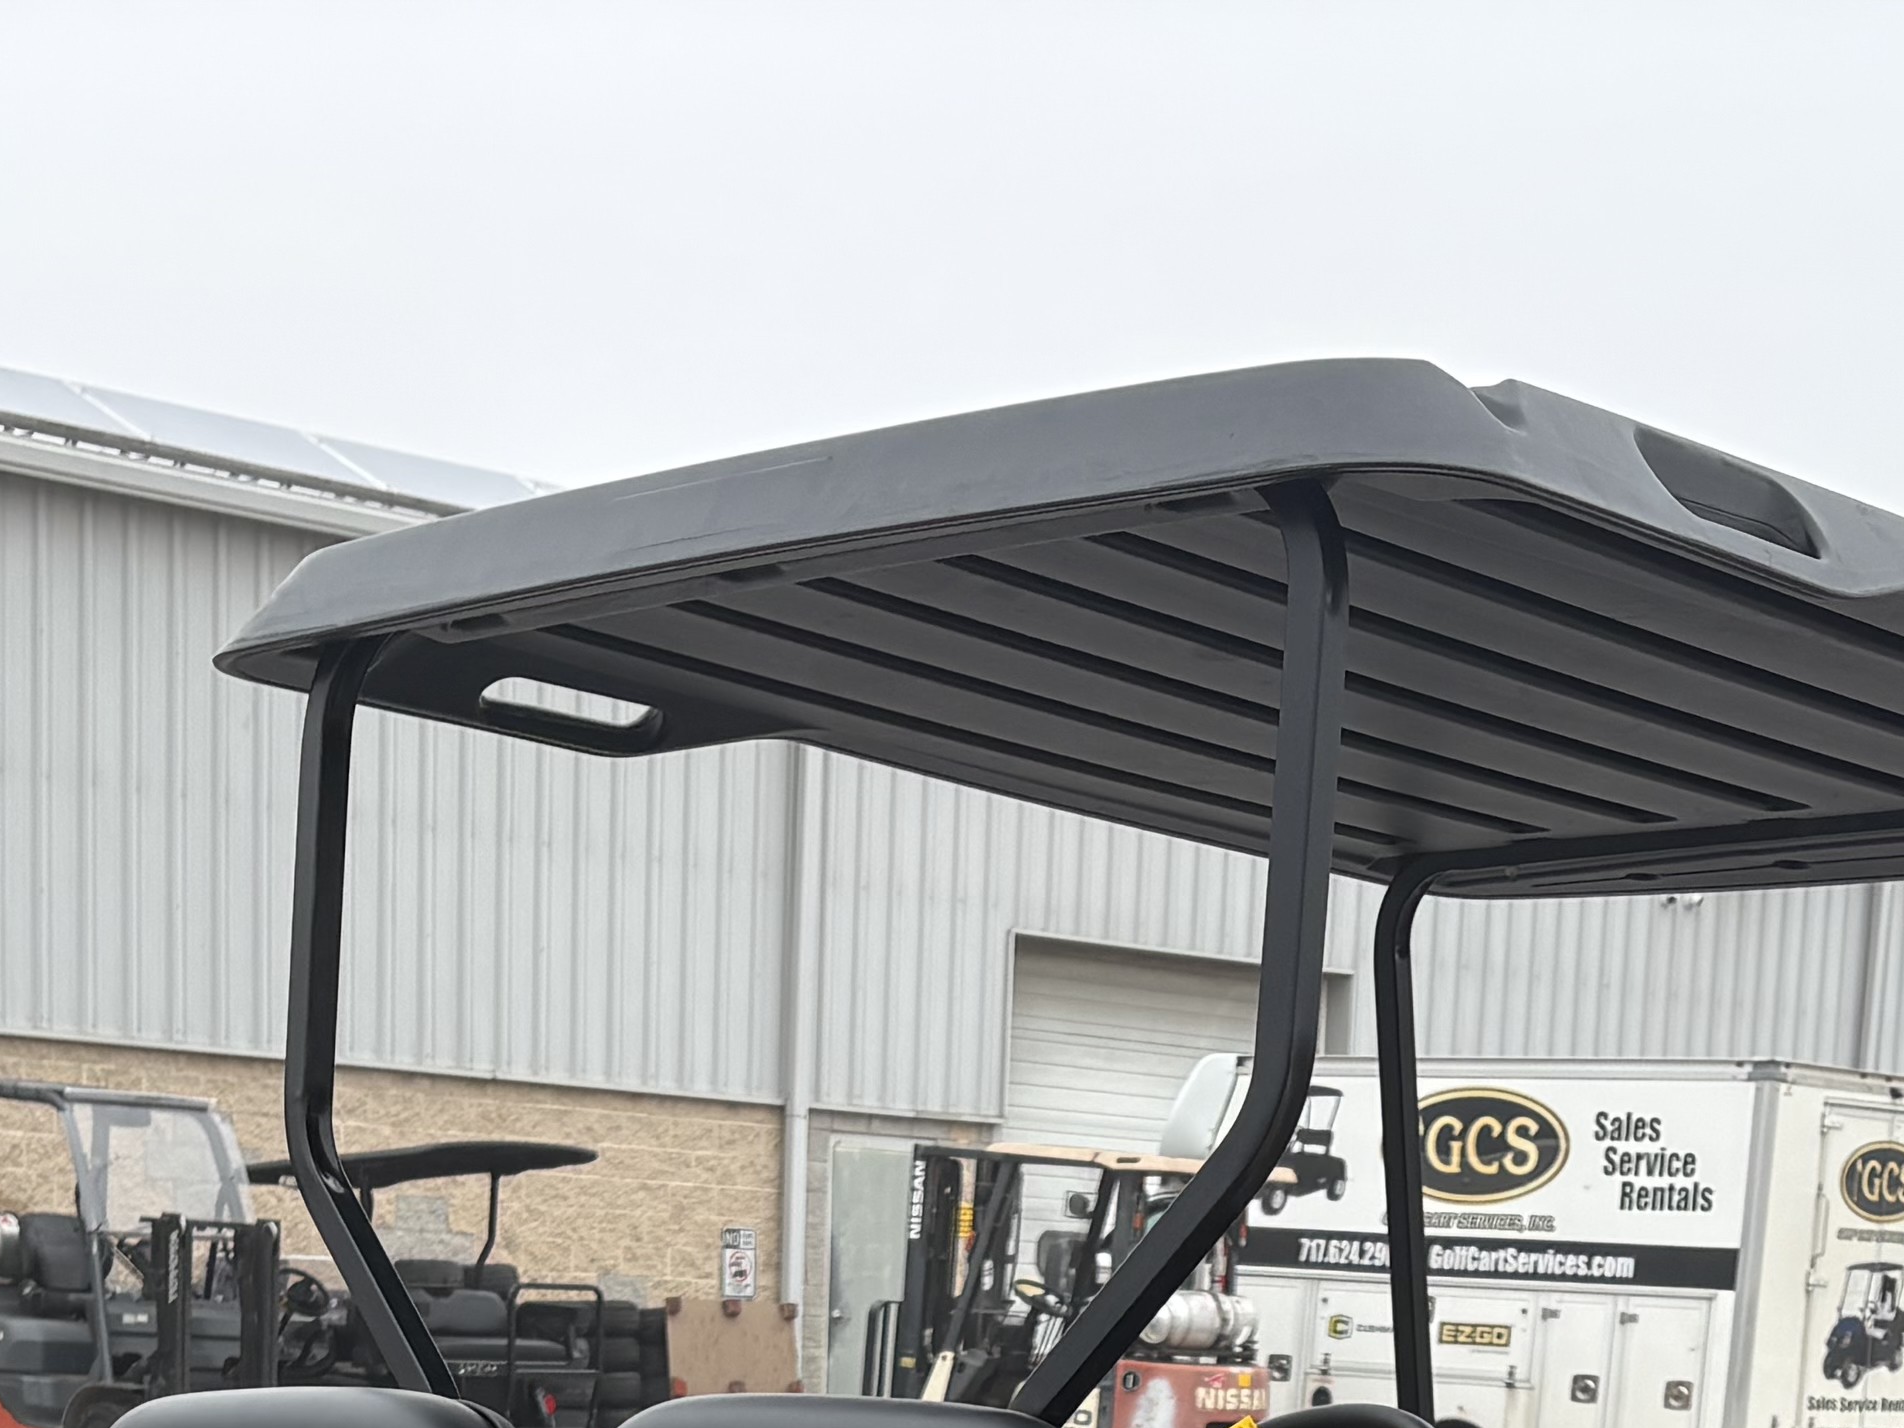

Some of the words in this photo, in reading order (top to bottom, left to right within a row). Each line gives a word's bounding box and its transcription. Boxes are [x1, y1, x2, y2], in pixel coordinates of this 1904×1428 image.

[1594, 1111, 1662, 1142] Sales
[1428, 1115, 1541, 1176] GCS
[1603, 1146, 1697, 1178] Service
[908, 1160, 926, 1240] NISSAN
[1619, 1181, 1714, 1213] Rentals
[1429, 1244, 1636, 1279] GolfCartServices.com
[1808, 1396, 1838, 1411] Sales
[1839, 1396, 1878, 1413] Service
